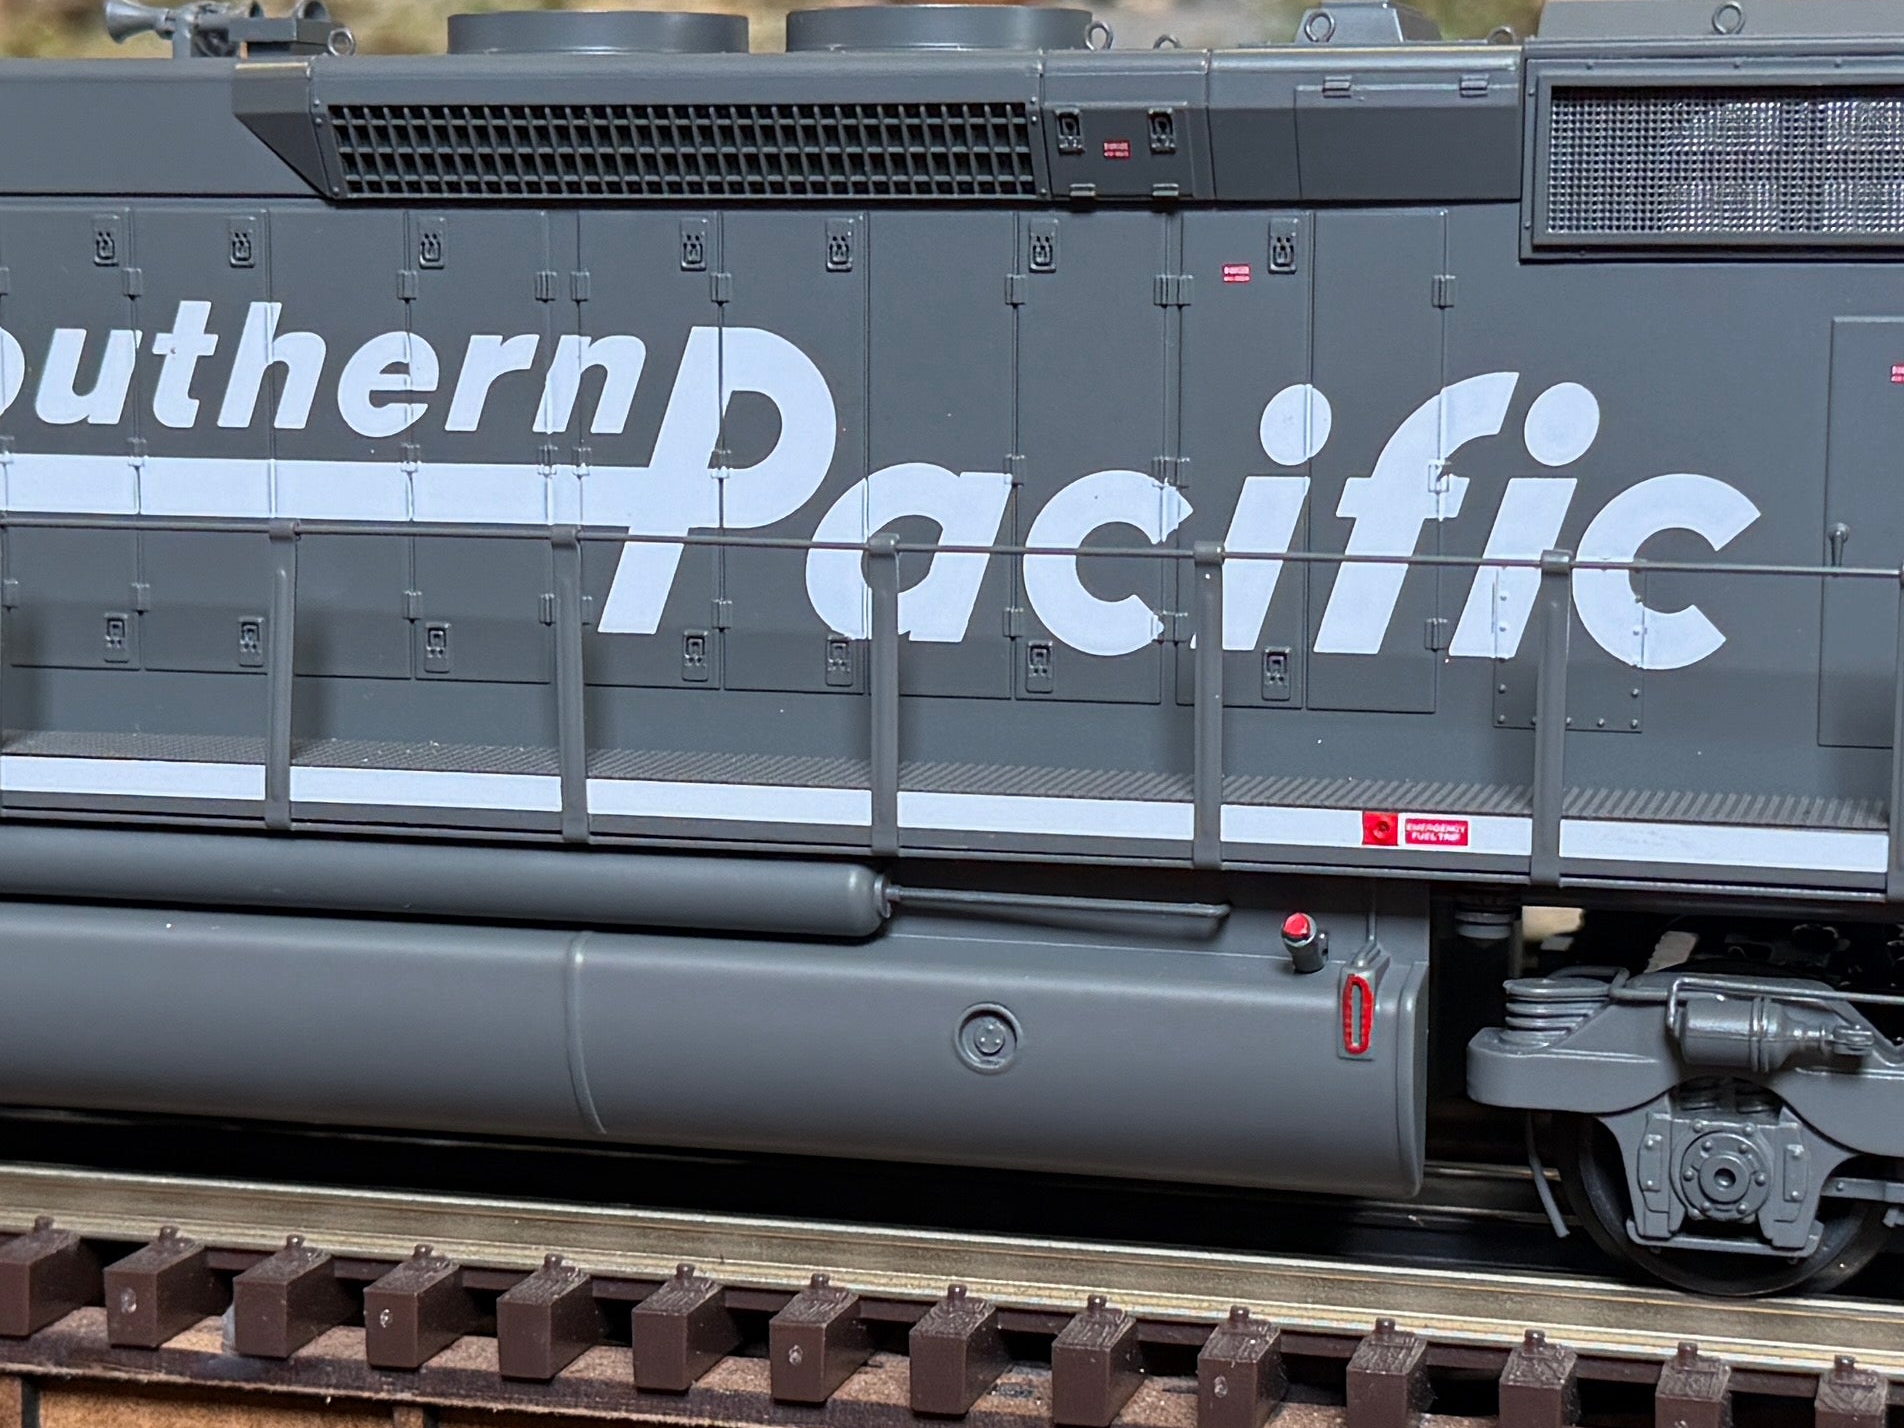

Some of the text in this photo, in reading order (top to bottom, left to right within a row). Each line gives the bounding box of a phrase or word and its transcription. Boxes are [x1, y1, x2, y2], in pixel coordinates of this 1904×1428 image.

[596, 325, 1762, 670] Pacific
[1406, 822, 1466, 834] EMERGENCY
[1411, 831, 1438, 841] FUEL
